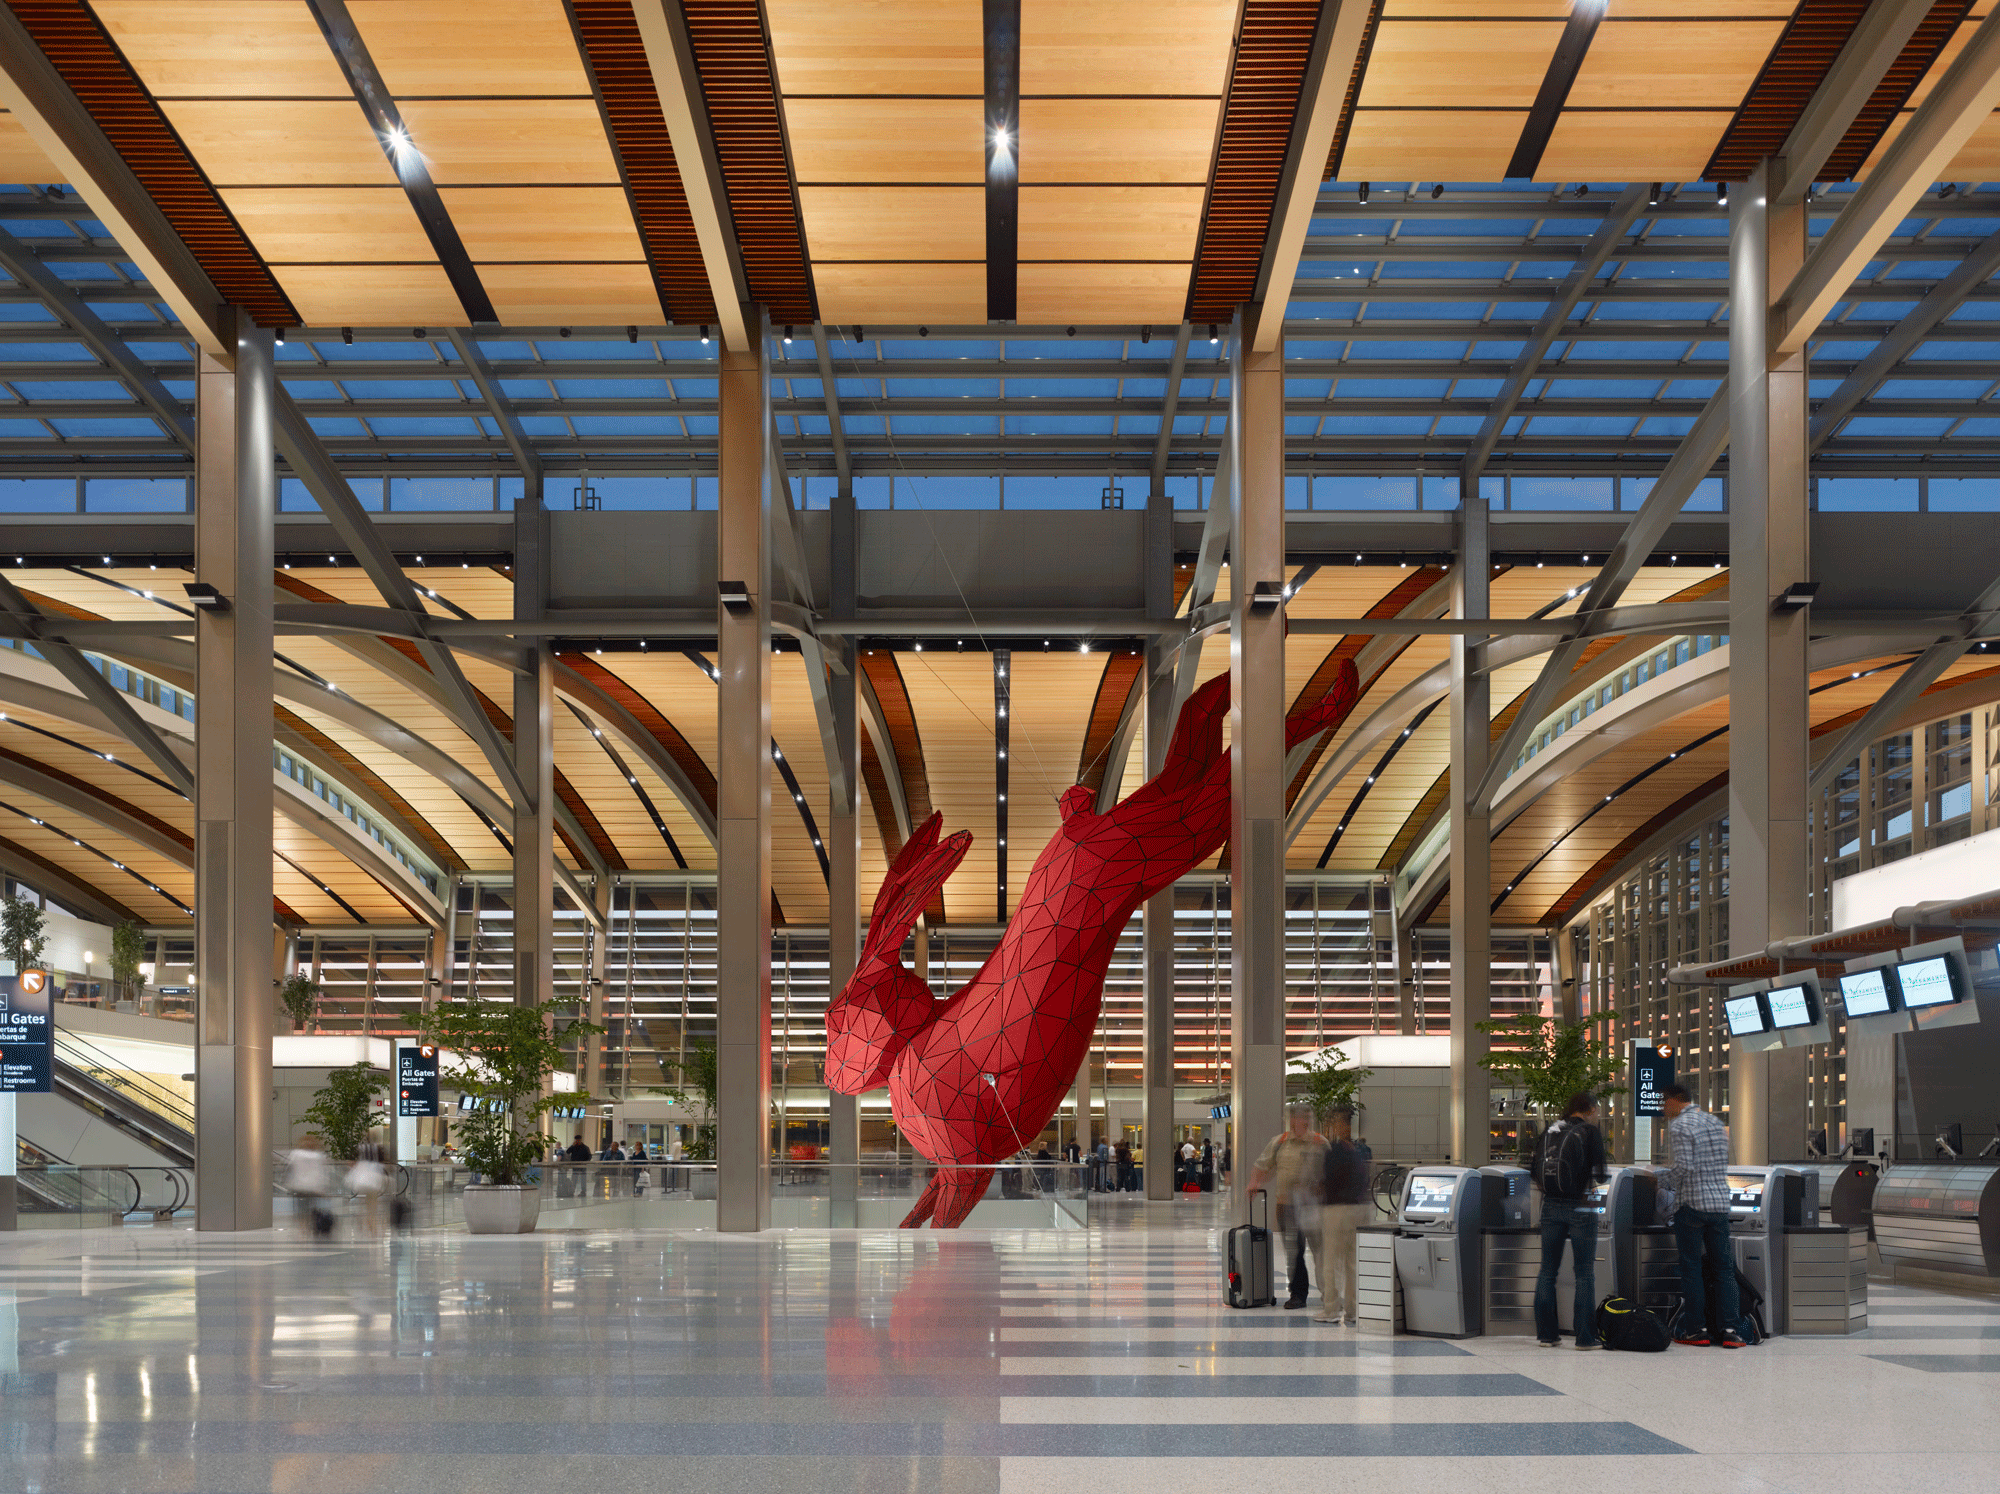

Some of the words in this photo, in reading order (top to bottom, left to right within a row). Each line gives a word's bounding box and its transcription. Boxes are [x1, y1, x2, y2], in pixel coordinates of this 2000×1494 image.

[11, 1013, 45, 1024] Gates
[0, 1033, 26, 1041] barque
[1640, 1082, 1653, 1090] All
